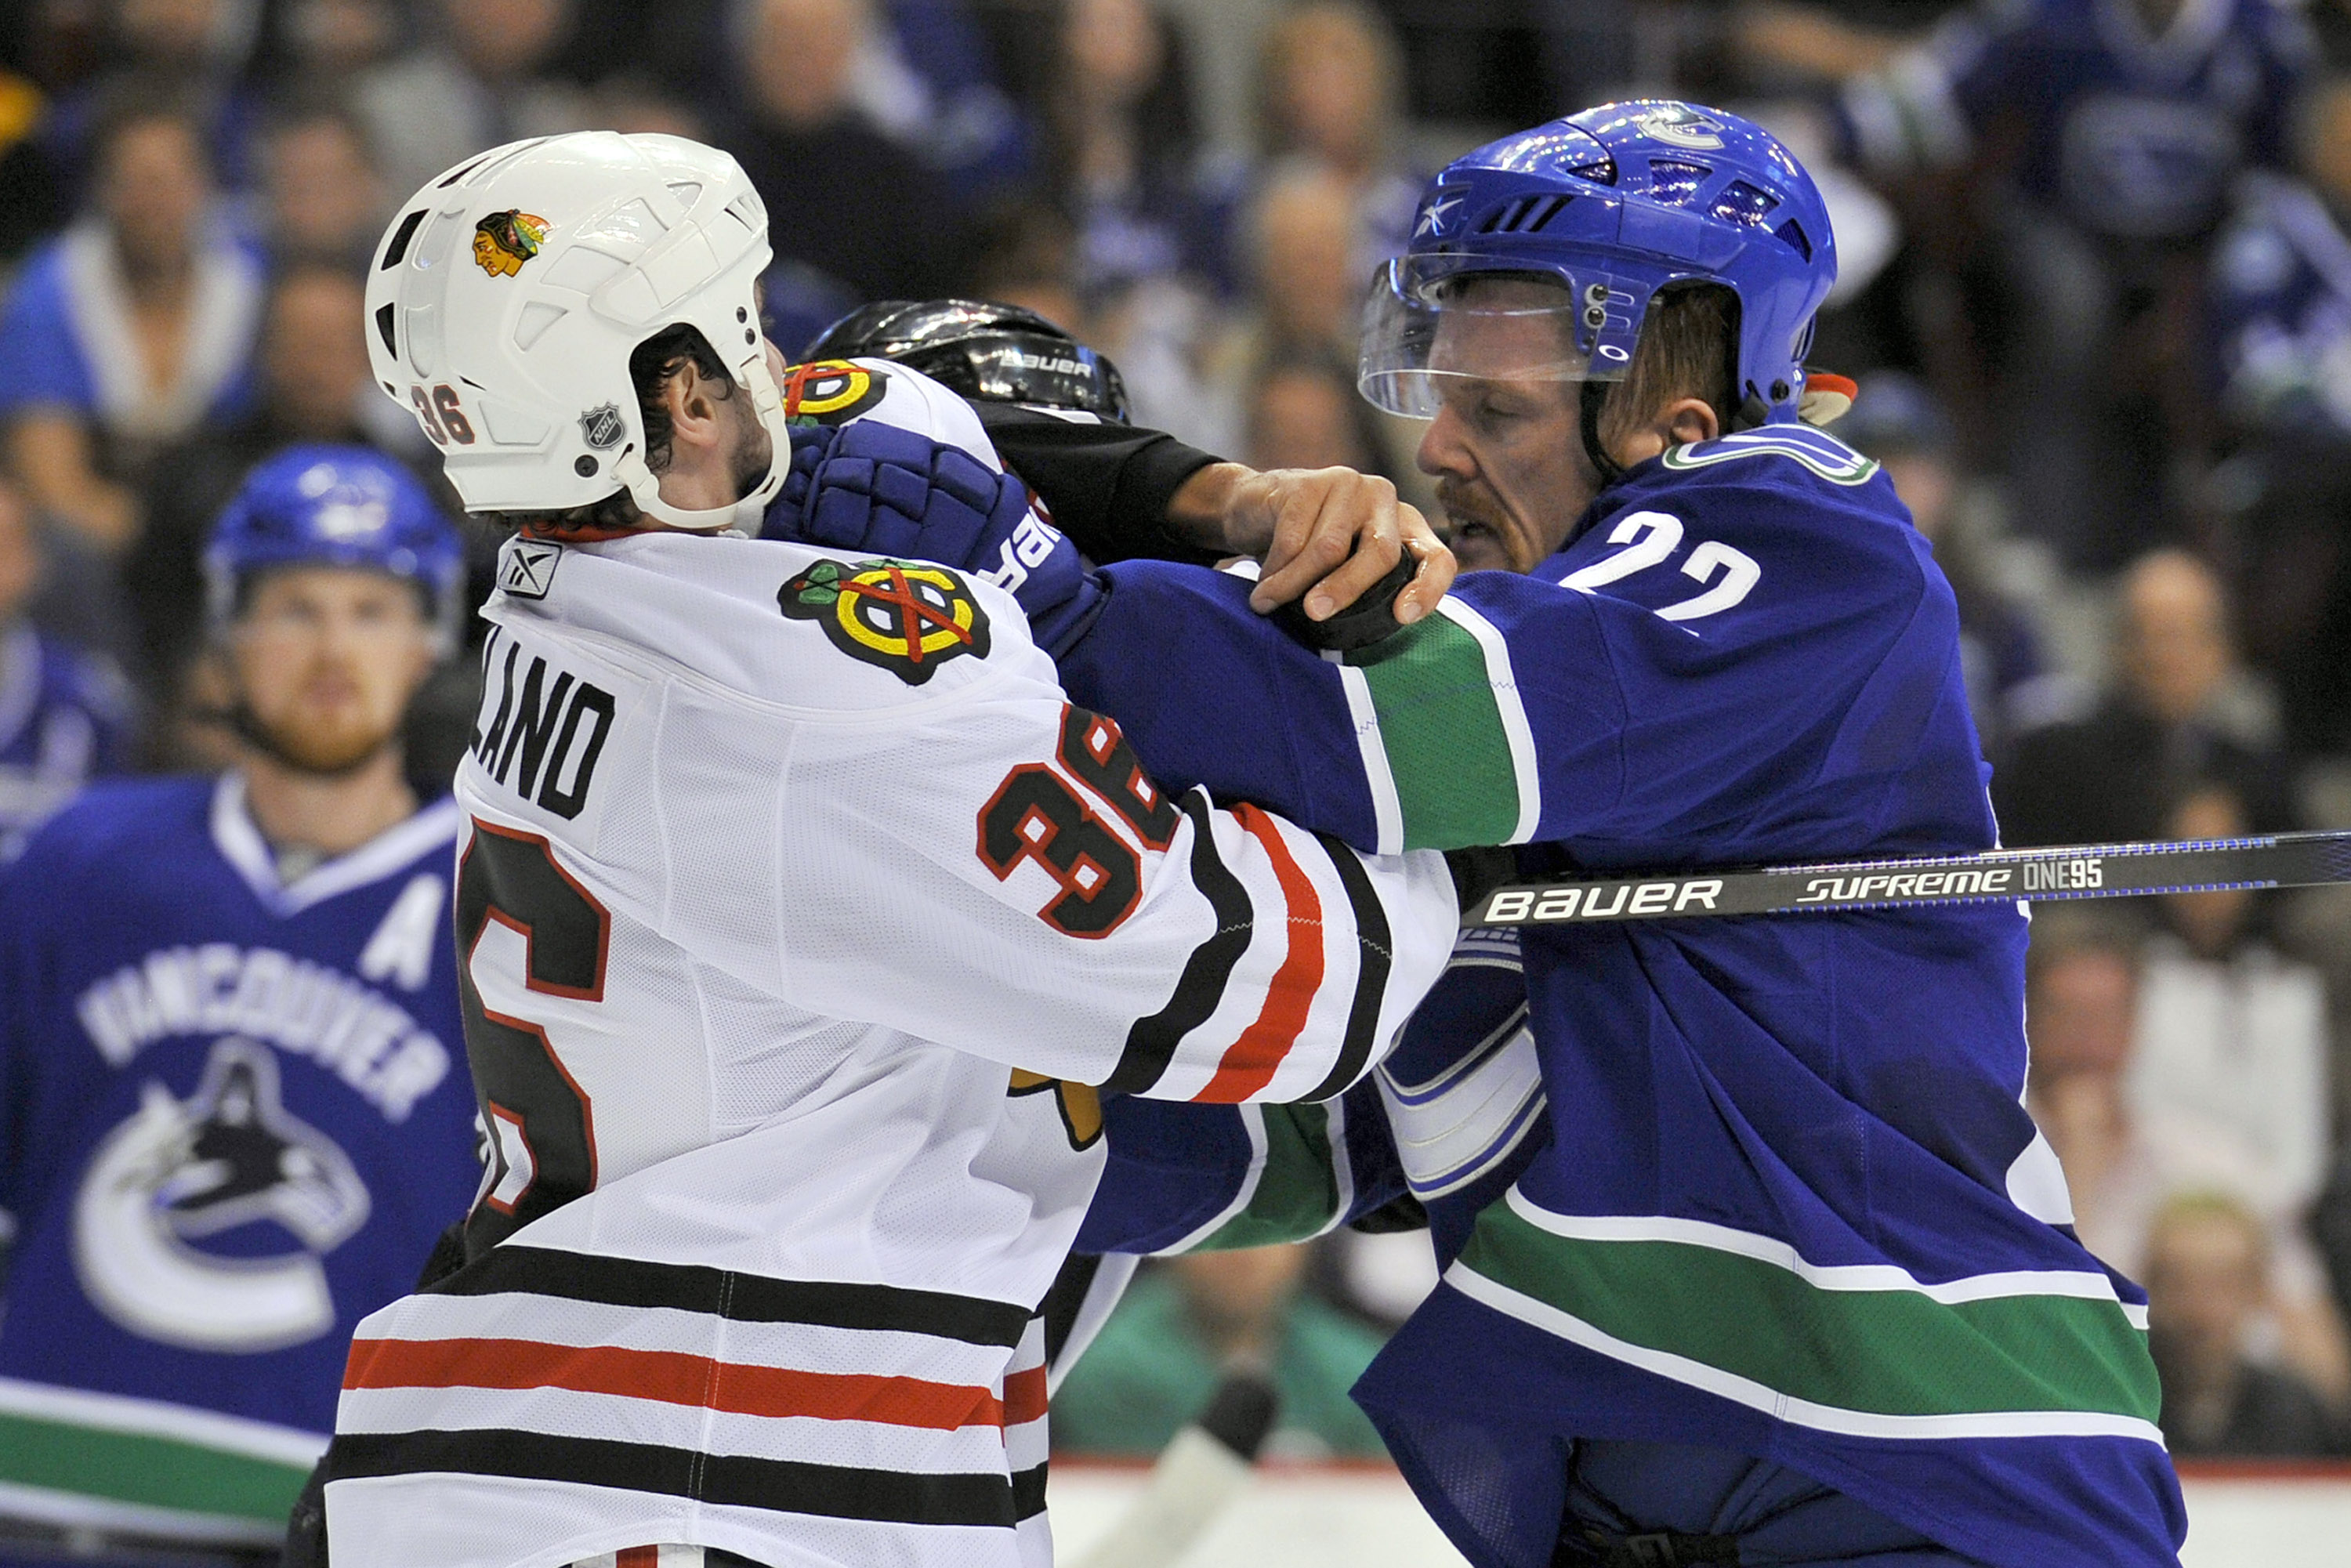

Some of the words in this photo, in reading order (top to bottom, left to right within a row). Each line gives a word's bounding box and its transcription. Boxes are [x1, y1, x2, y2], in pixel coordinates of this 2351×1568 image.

[411, 382, 475, 446] 36
[1557, 510, 1762, 637] 22
[975, 701, 1183, 941] 36
[1796, 869, 2012, 903] SUPREME
[2023, 858, 2103, 891] ONE95
[358, 873, 445, 993] A
[1483, 878, 1724, 922] BAUER
[77, 942, 452, 1124] VANCOUVER
